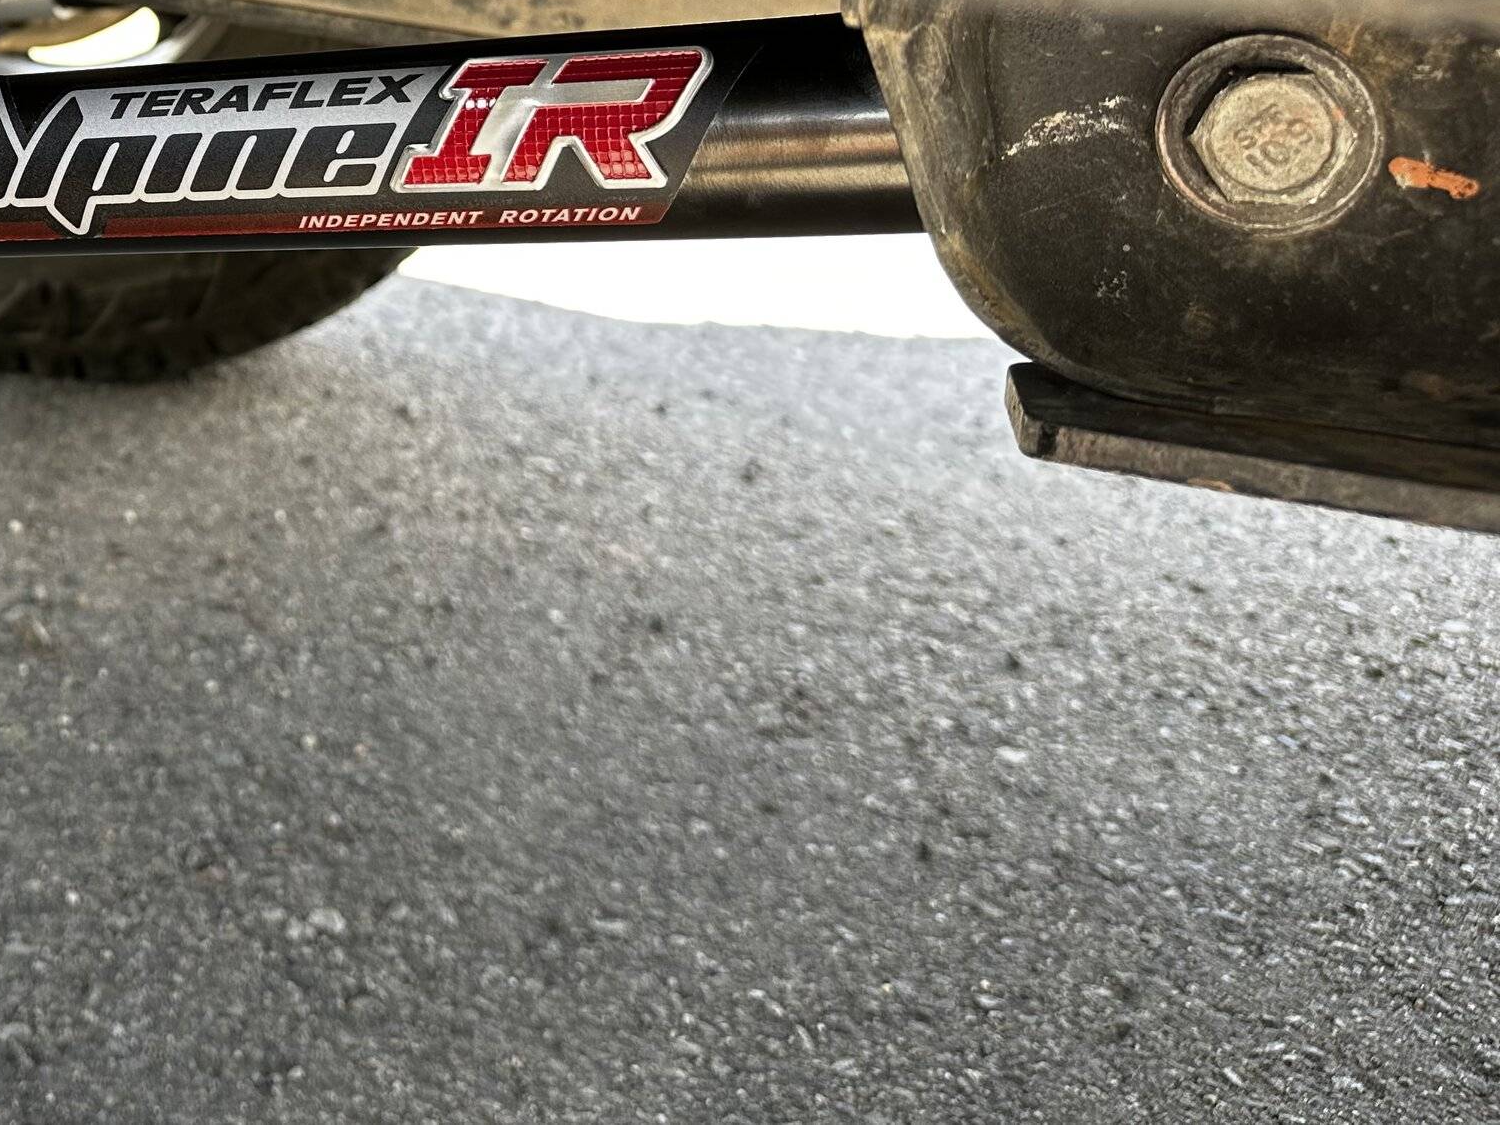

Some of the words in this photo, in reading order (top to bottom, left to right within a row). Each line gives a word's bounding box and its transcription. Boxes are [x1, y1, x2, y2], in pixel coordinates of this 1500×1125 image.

[109, 73, 425, 120] TERAFLEX
[390, 45, 714, 194] IR
[298, 209, 484, 229] INDEPENDENT
[498, 205, 642, 225] ROTATION
